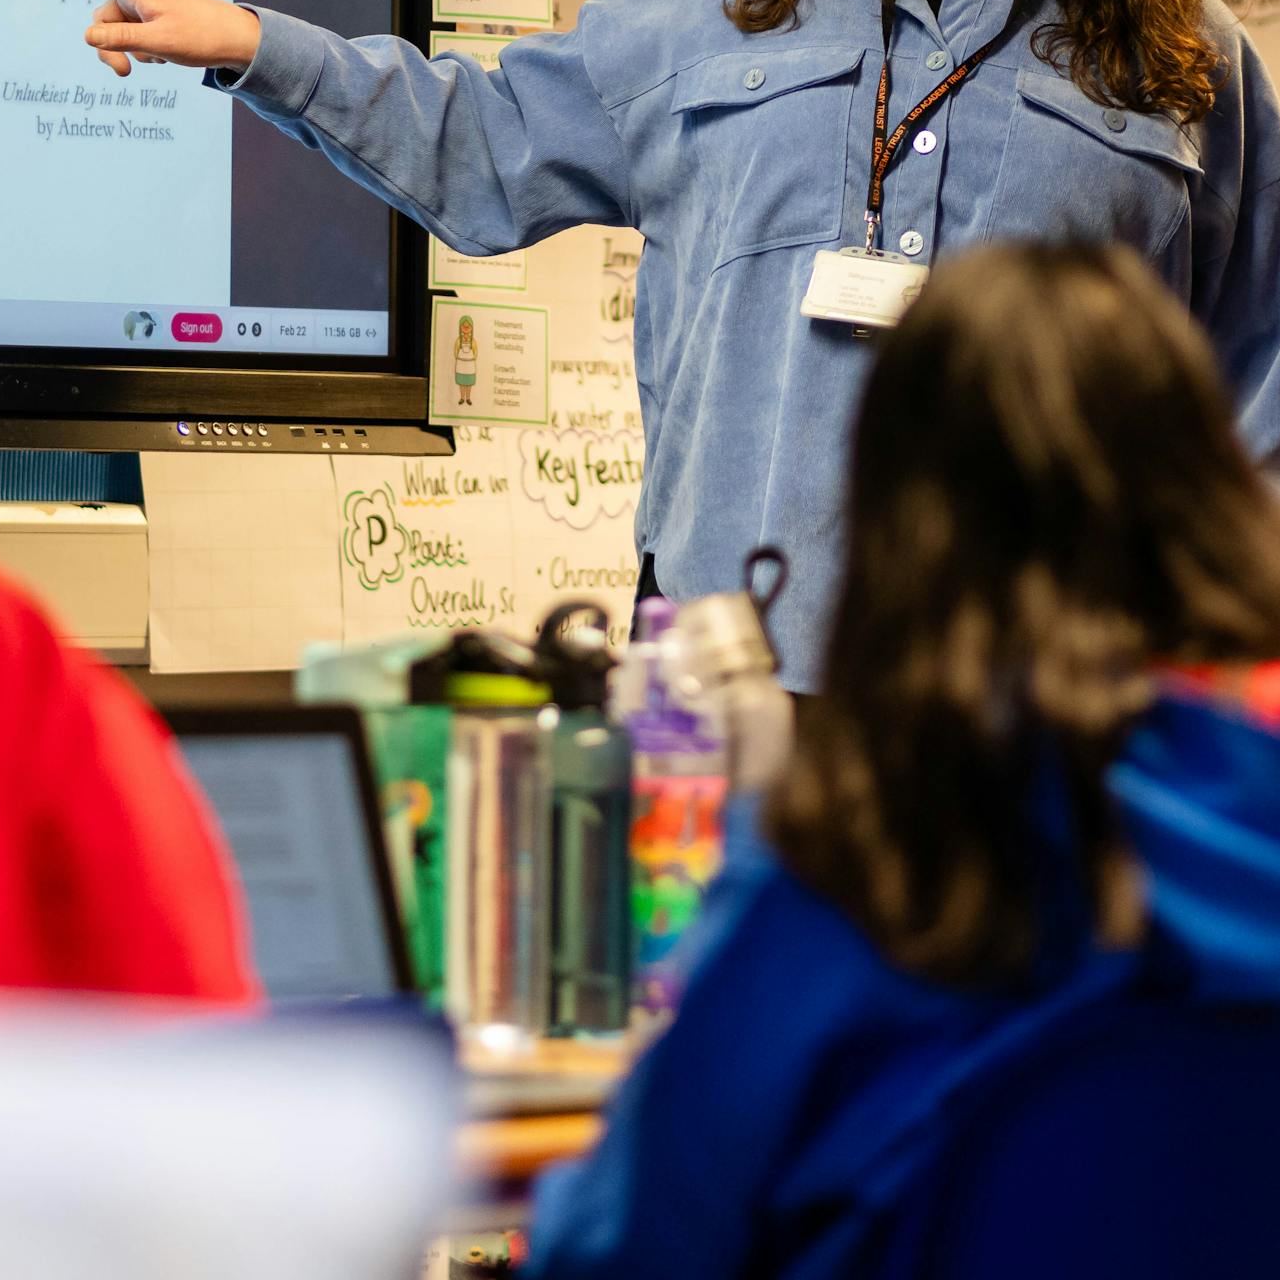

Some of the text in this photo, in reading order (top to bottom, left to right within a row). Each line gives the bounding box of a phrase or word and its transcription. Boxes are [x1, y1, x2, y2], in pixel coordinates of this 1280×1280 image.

[2, 81, 70, 102] Unluckiest
[72, 84, 96, 108] Boy
[99, 86, 113, 104] in
[116, 86, 135, 105] the
[140, 88, 177, 107] World
[908, 65, 968, 121] LEO ACADEMY TRUST
[36, 115, 174, 139] by Andrew Norriss.
[876, 105, 885, 129] TRUST
[874, 151, 891, 189] ACADEMY
[887, 124, 906, 151] TRUST
[180, 322, 213, 335] Sign out
[280, 325, 306, 336] Feb 22
[324, 326, 360, 338] 11:56 GB
[404, 462, 450, 497] What
[536, 444, 578, 506] Key
[368, 514, 386, 556] P
[411, 576, 495, 622] Overall,
